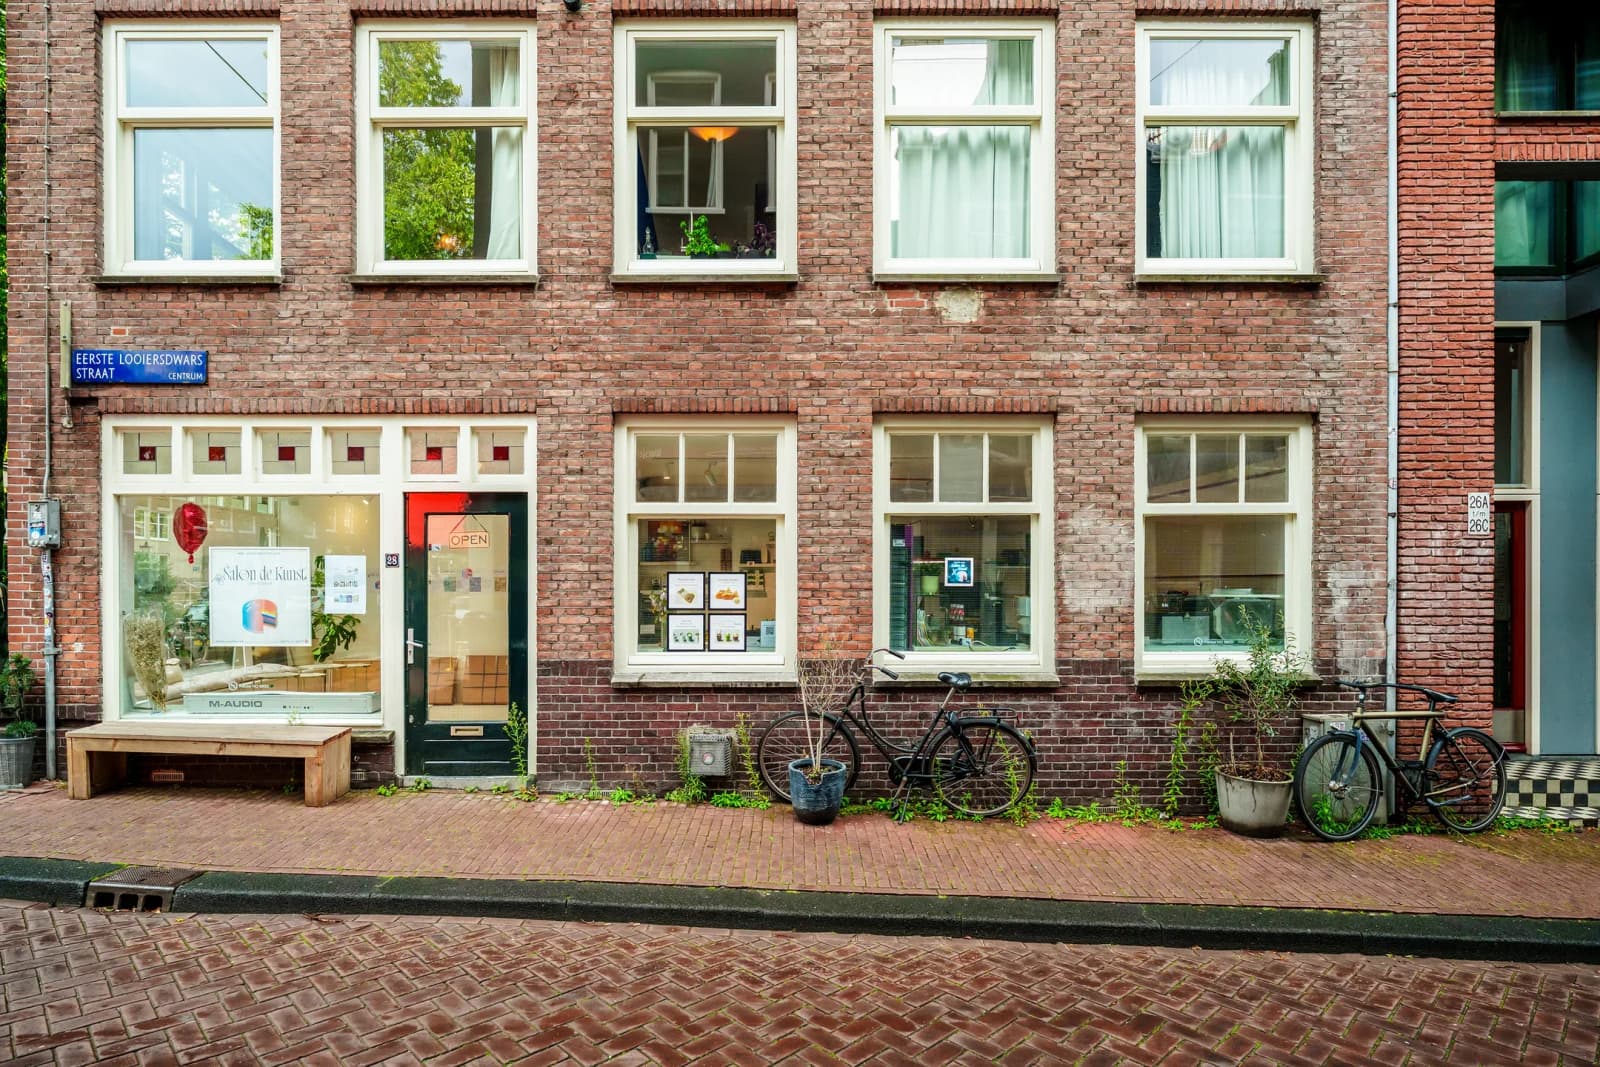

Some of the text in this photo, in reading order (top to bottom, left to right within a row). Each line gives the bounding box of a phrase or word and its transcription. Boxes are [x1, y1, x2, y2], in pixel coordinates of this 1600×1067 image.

[76, 353, 203, 366] EERSTE LOOIERSDWARS
[76, 367, 115, 379] STRAAT
[168, 372, 203, 380] CENTRUM
[1469, 495, 1488, 508] 26A
[1469, 519, 1488, 532] 26C
[451, 534, 487, 546] OPEN
[386, 555, 398, 565] 28
[223, 564, 256, 581] Salon
[260, 564, 273, 581] de
[209, 700, 263, 708] M-AUDIO
